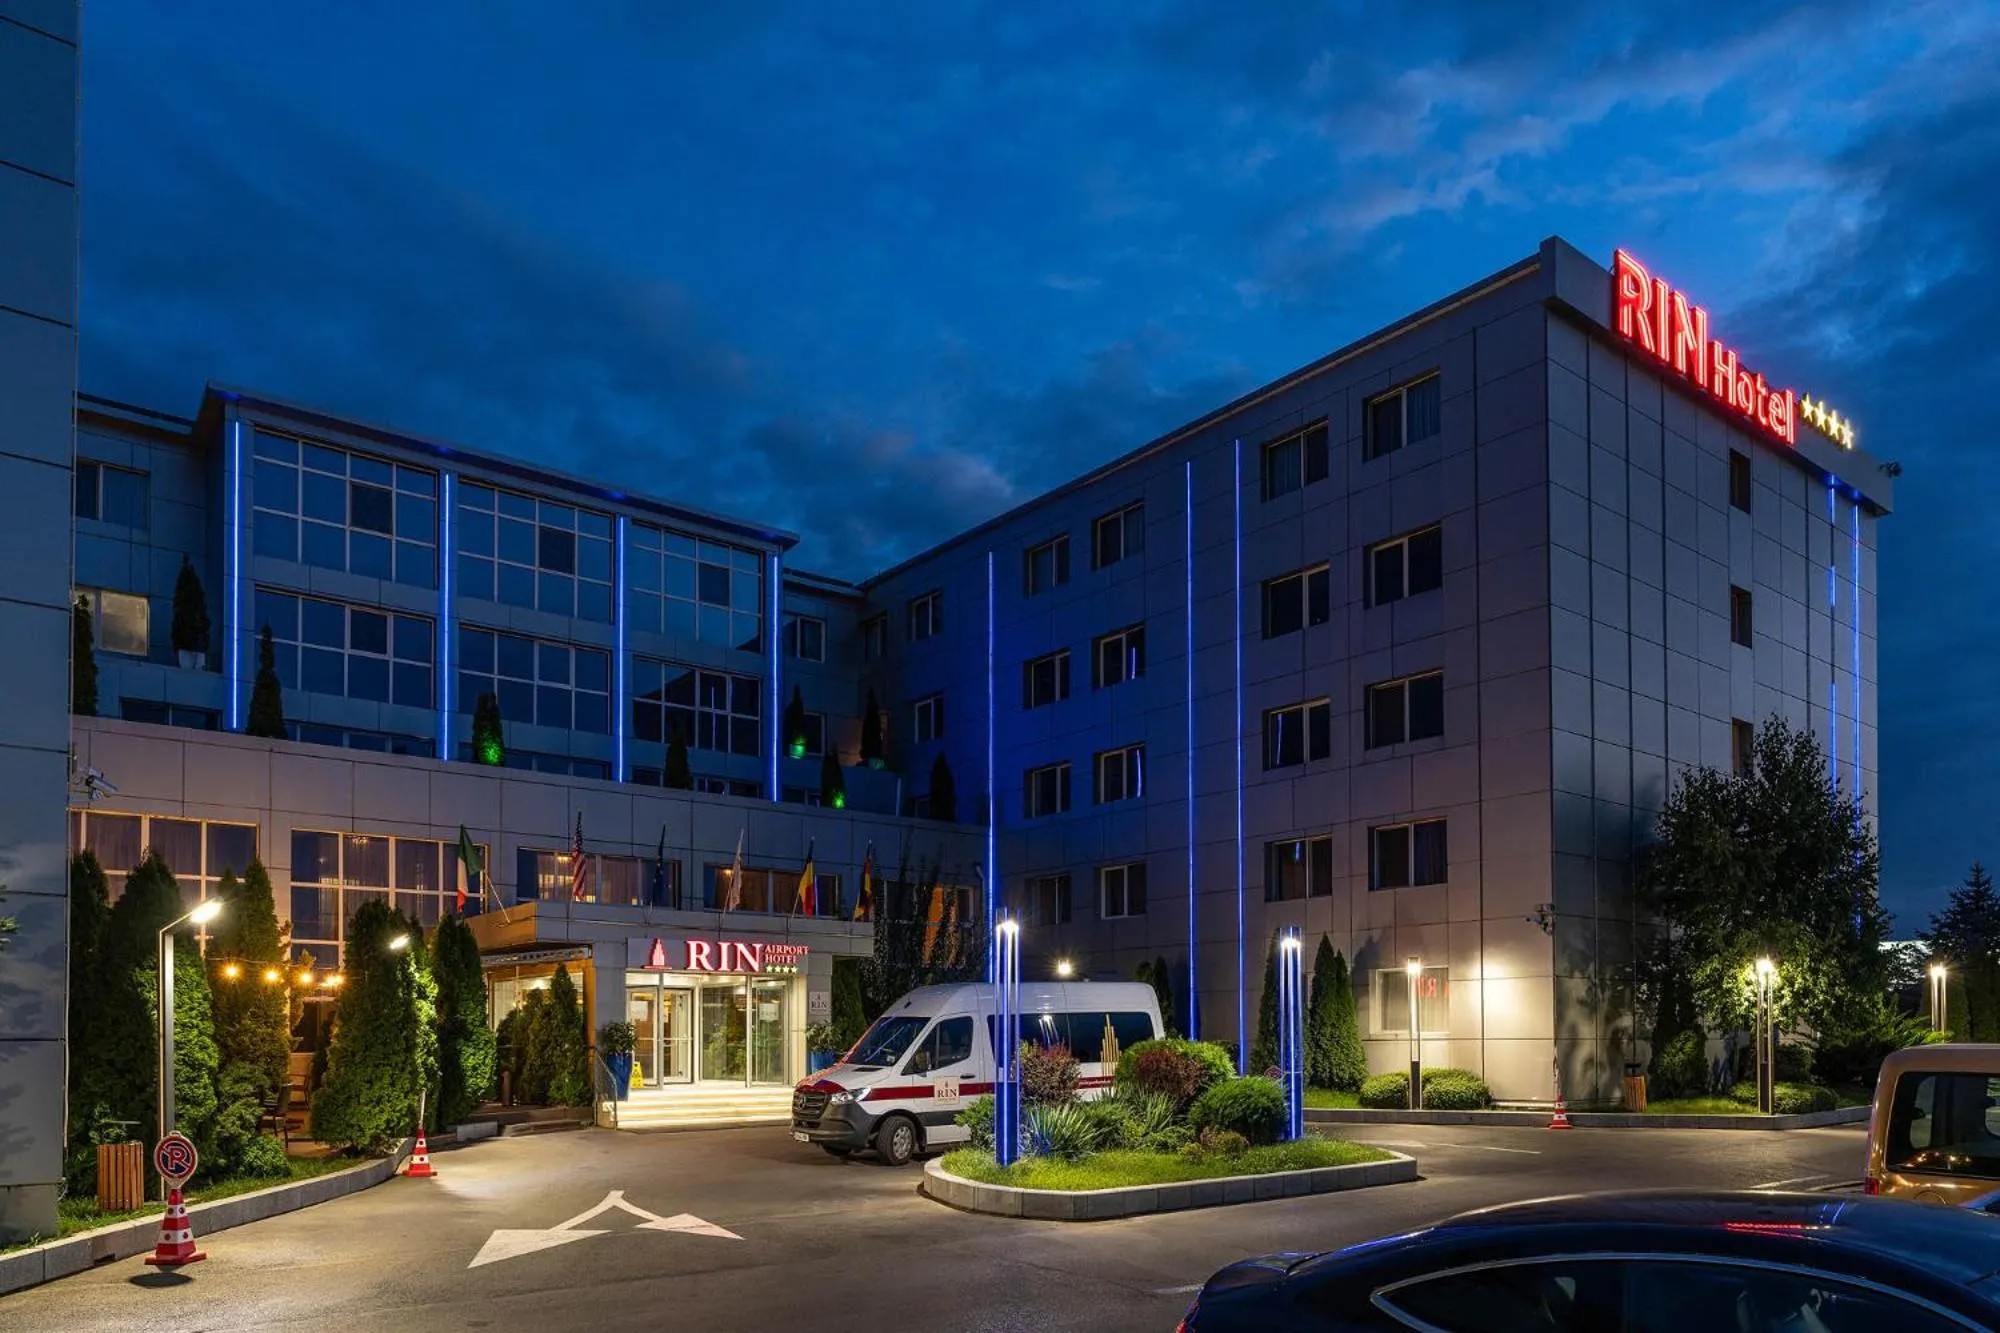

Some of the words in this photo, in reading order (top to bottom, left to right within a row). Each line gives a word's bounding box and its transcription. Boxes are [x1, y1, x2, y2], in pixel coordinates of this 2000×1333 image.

[1613, 249, 1708, 391] RIN
[1710, 339, 1797, 448] Hotel
[686, 939, 763, 973] RIN
[764, 944, 809, 956] AIRPORT
[764, 953, 798, 965] HOTEL
[811, 1001, 828, 1009] RIN
[937, 1088, 957, 1098] RIN
